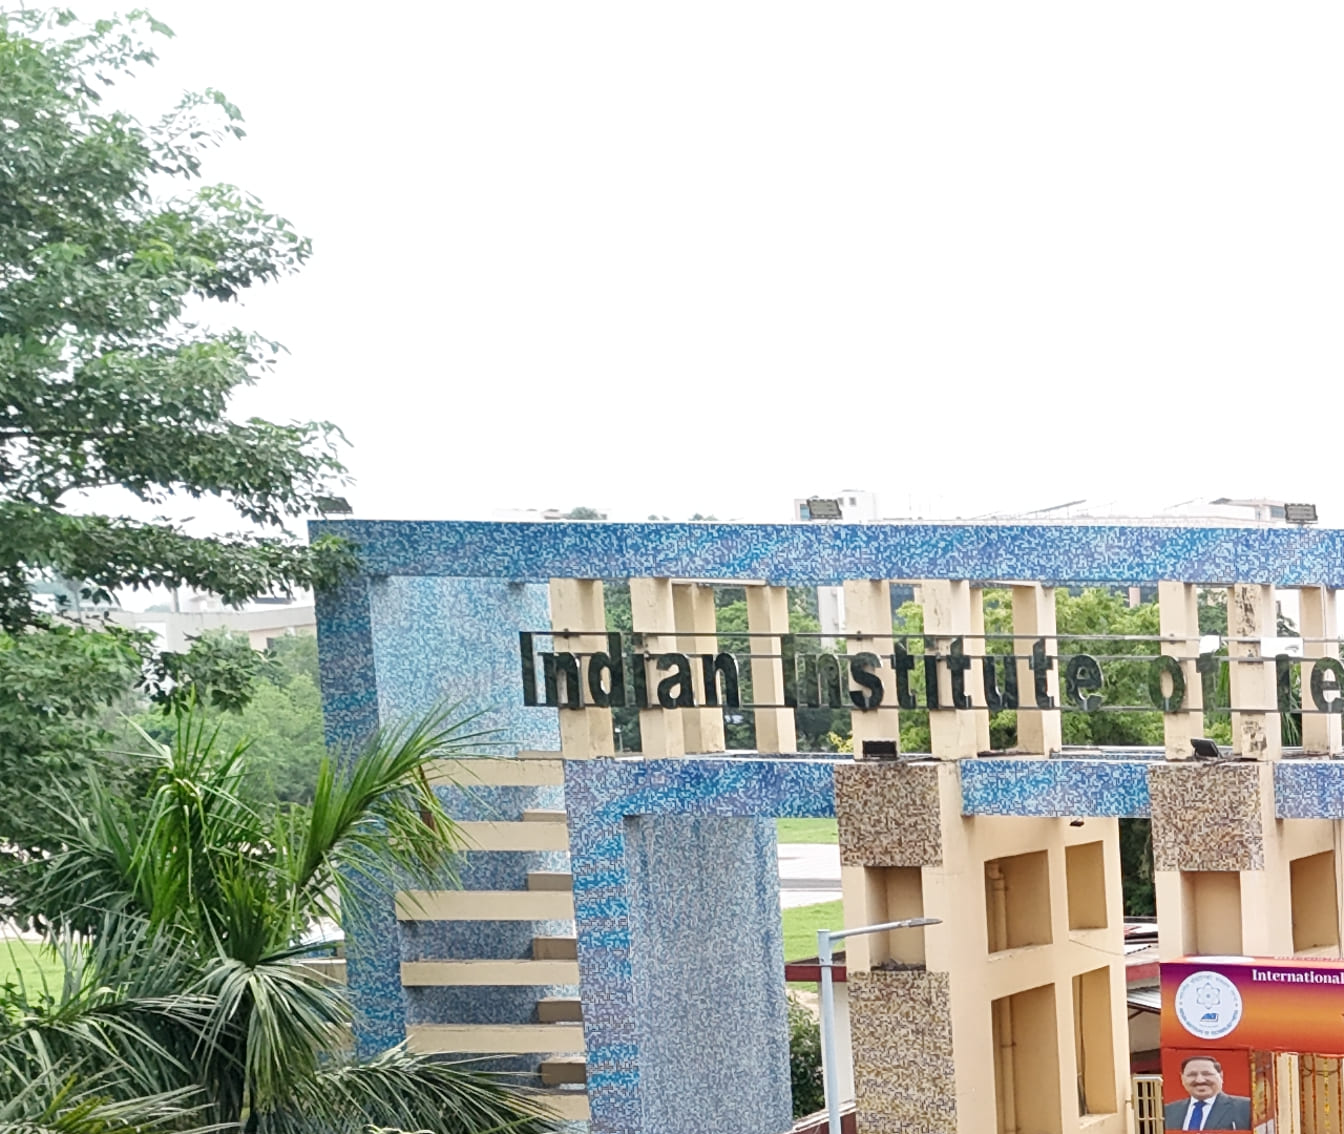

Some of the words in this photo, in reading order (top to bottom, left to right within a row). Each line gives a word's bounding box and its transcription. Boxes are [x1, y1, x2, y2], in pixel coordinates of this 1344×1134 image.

[519, 631, 741, 710] Indian
[781, 632, 1103, 712] Institute
[1149, 635, 1221, 713] of
[1252, 968, 1344, 985] International
